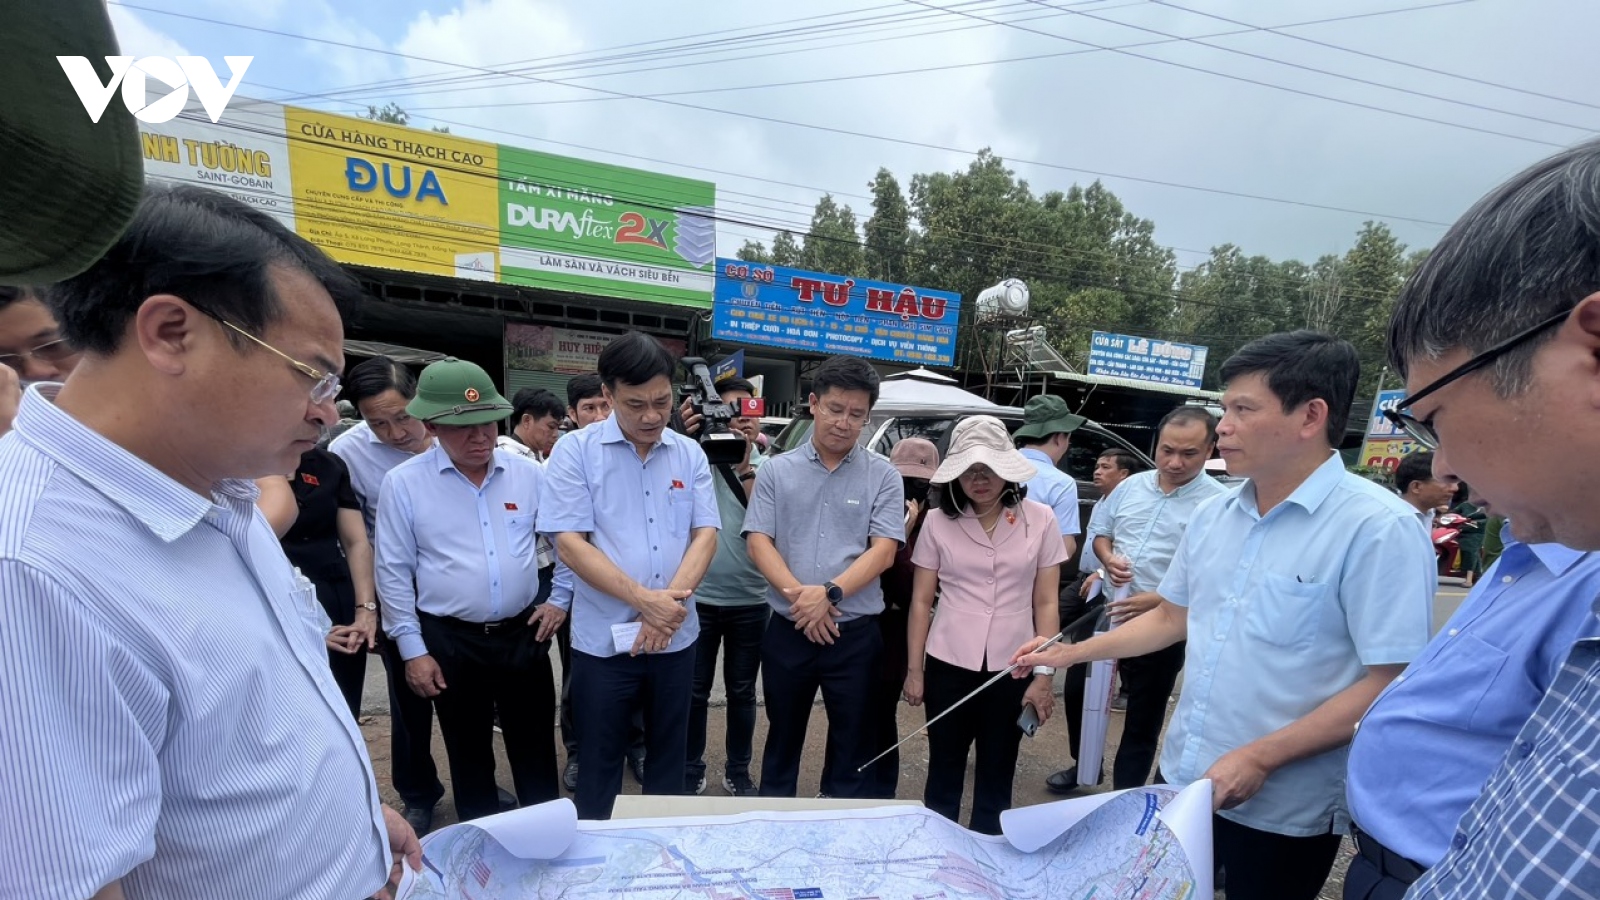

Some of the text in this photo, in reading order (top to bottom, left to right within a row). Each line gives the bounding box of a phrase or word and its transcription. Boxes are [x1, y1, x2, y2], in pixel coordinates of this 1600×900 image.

[141, 131, 272, 178] NH TƯỜNG
[301, 122, 484, 166] CỬA HÀNG THẠCH CAO
[197, 170, 273, 190] SAINT-GOBAIN
[345, 156, 449, 206] ĐUA
[539, 255, 680, 283] LÀM SÀN VÀ VÁCH SIÊU BỀN
[725, 263, 775, 283] CƠ SỞ
[790, 276, 948, 321] TƯ HẬU
[825, 332, 864, 344] PHOTOCOPY
